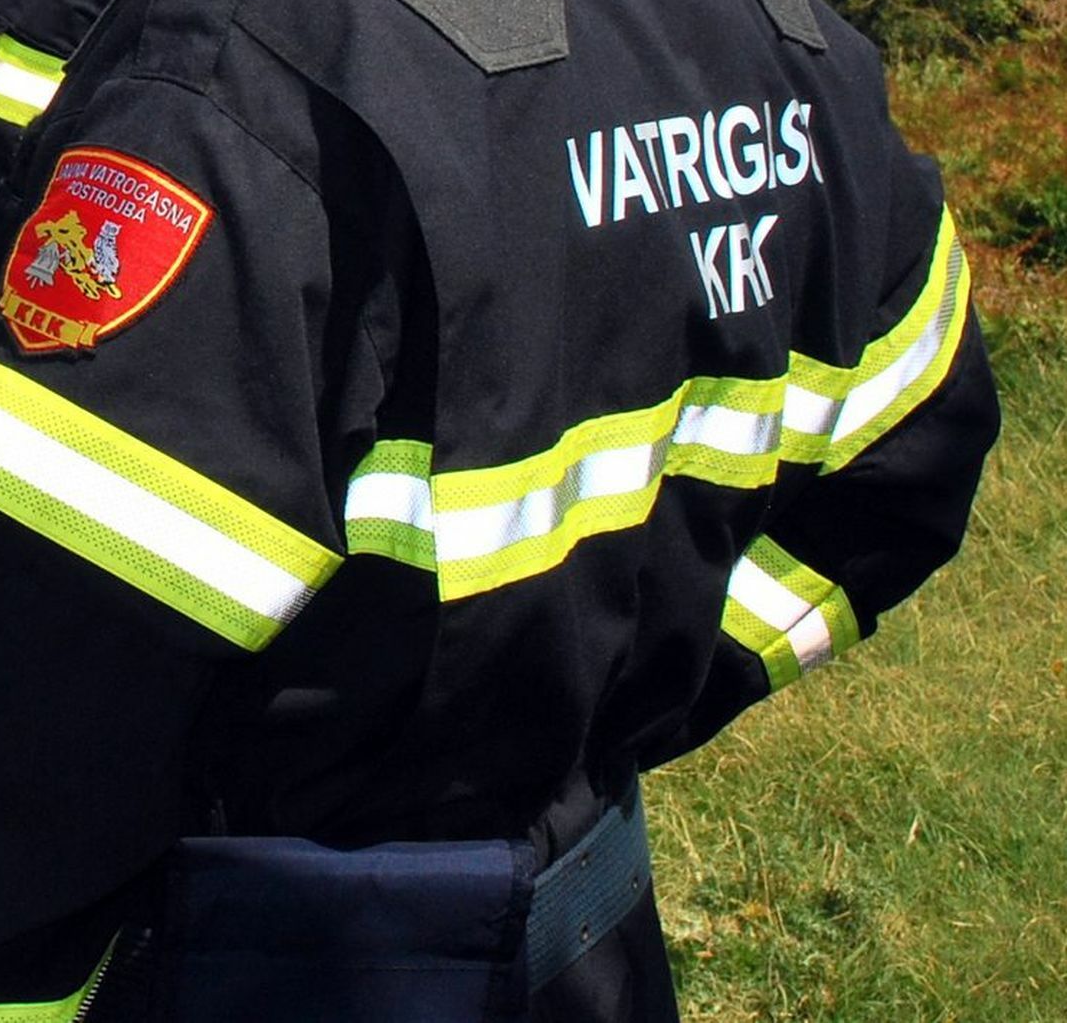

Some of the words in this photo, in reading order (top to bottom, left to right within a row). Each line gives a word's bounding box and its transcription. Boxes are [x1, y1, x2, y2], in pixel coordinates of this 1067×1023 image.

[66, 179, 147, 224] POSTROJBA
[89, 163, 194, 234] VATROGASNA
[689, 214, 779, 320] KRK
[13, 301, 66, 340] KRK
